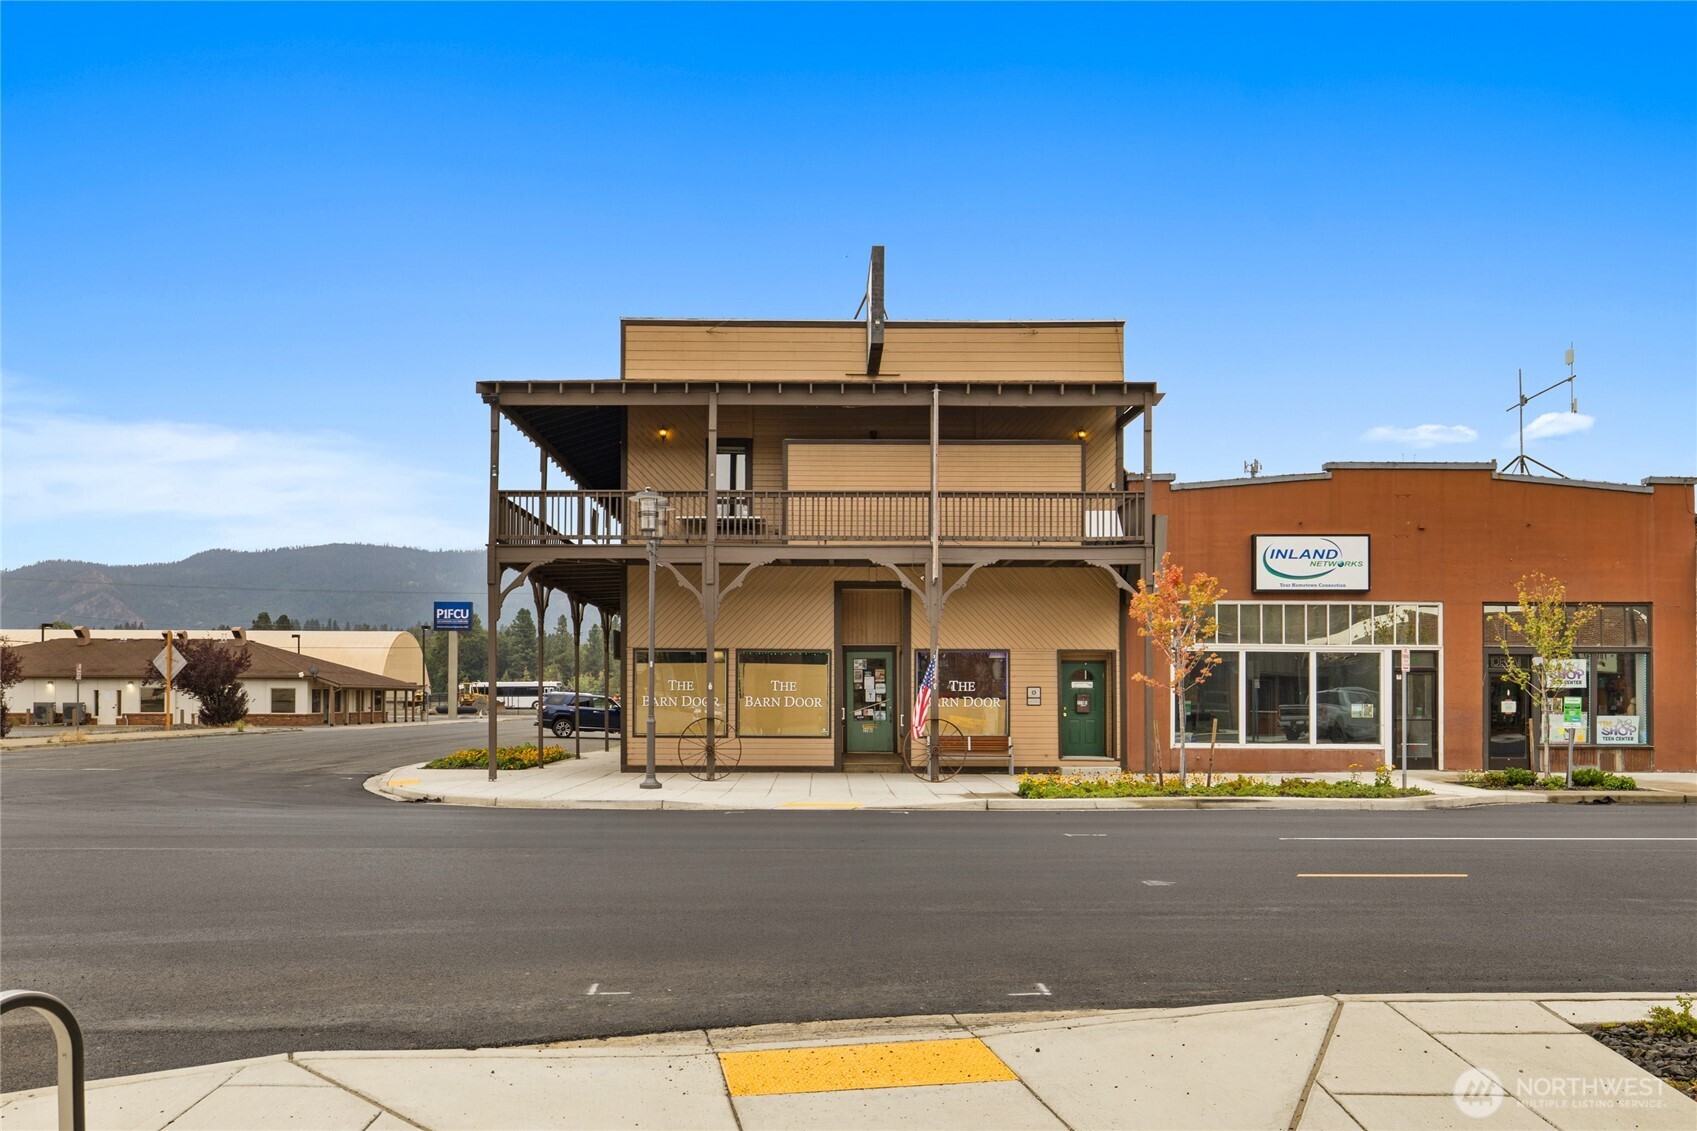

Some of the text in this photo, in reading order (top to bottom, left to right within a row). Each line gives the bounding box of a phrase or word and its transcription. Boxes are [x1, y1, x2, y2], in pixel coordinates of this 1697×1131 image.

[1269, 548, 1338, 560] INLAND
[1309, 560, 1364, 568] NETWORKS
[436, 608, 469, 619] P1FCU
[667, 679, 694, 691] THE
[770, 680, 797, 692] THE
[949, 680, 976, 692] THE
[744, 695, 823, 708] BARN DOOR
[928, 696, 1001, 708] RN DOOR
[1601, 725, 1637, 736] SHOP
